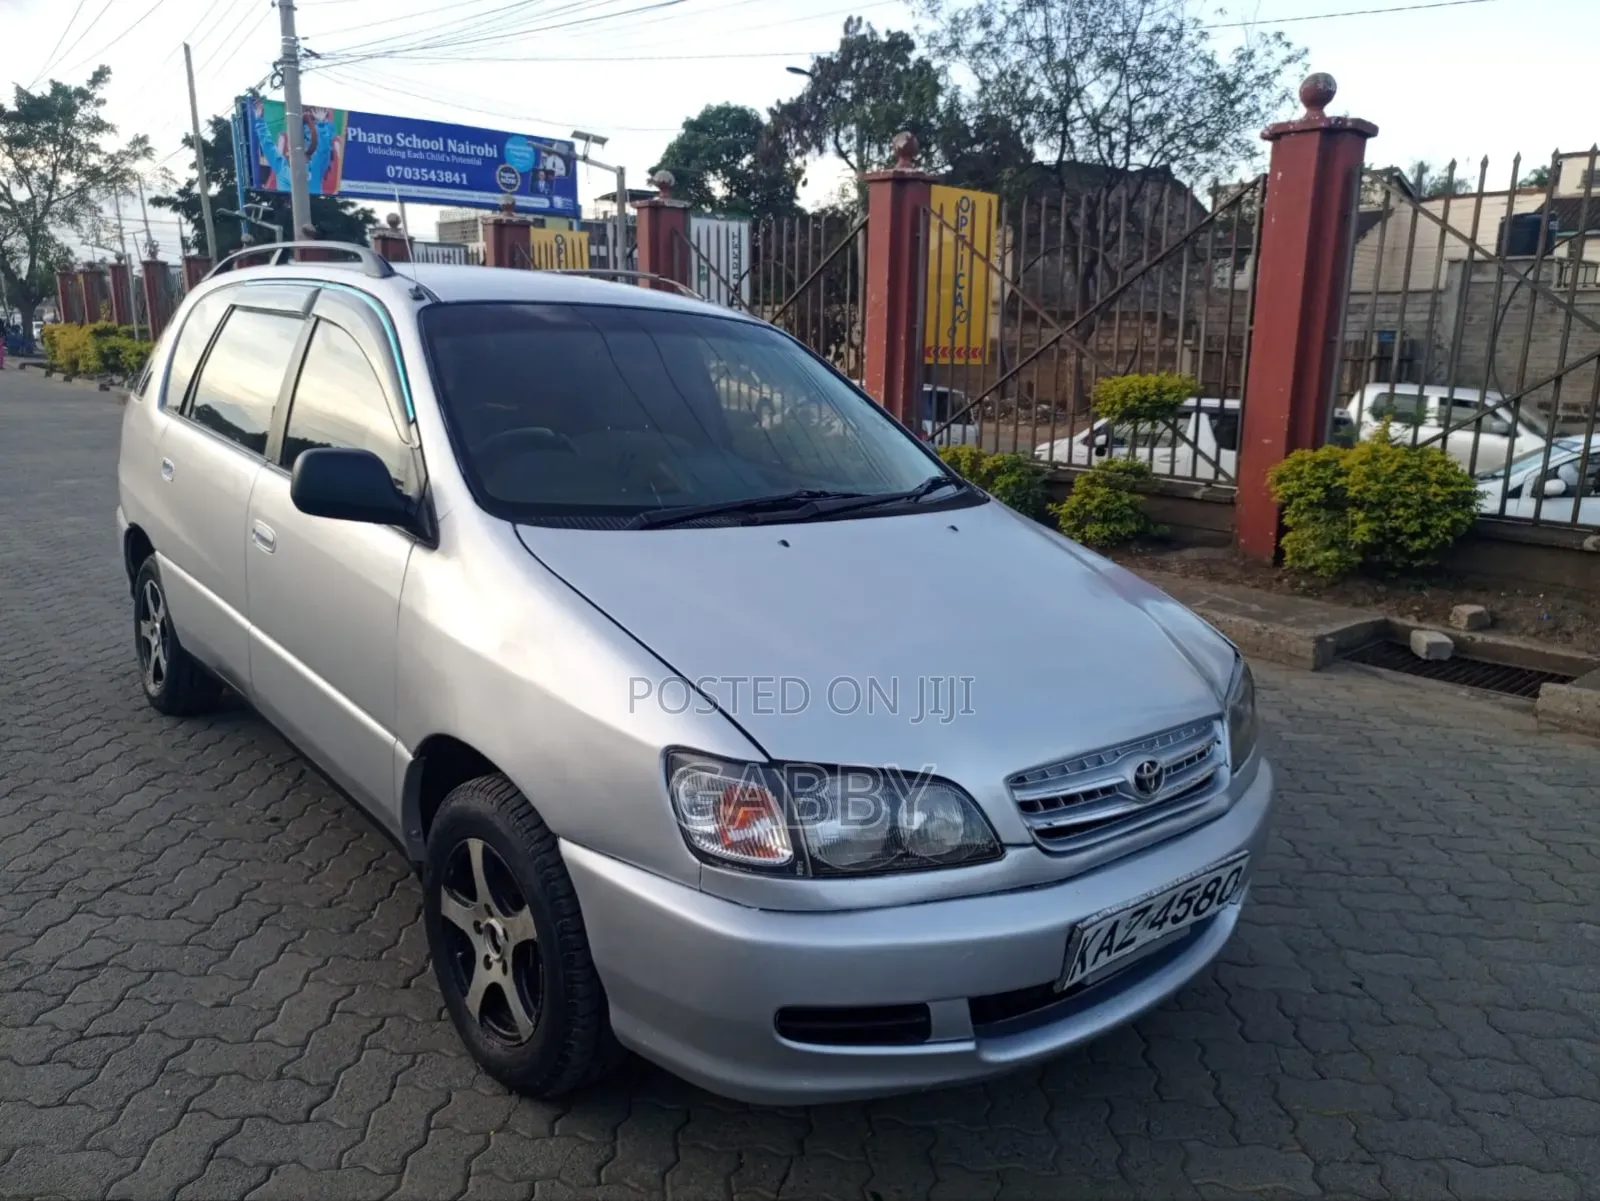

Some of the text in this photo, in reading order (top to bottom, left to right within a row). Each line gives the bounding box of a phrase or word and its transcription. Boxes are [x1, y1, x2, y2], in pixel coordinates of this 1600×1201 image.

[347, 127, 393, 146] Pharo
[395, 132, 444, 152] School
[447, 138, 498, 159] Nairobi
[368, 145, 406, 159] Unlocking
[407, 150, 425, 160] Each
[451, 154, 482, 166] Potential
[386, 165, 468, 185] 0703543841
